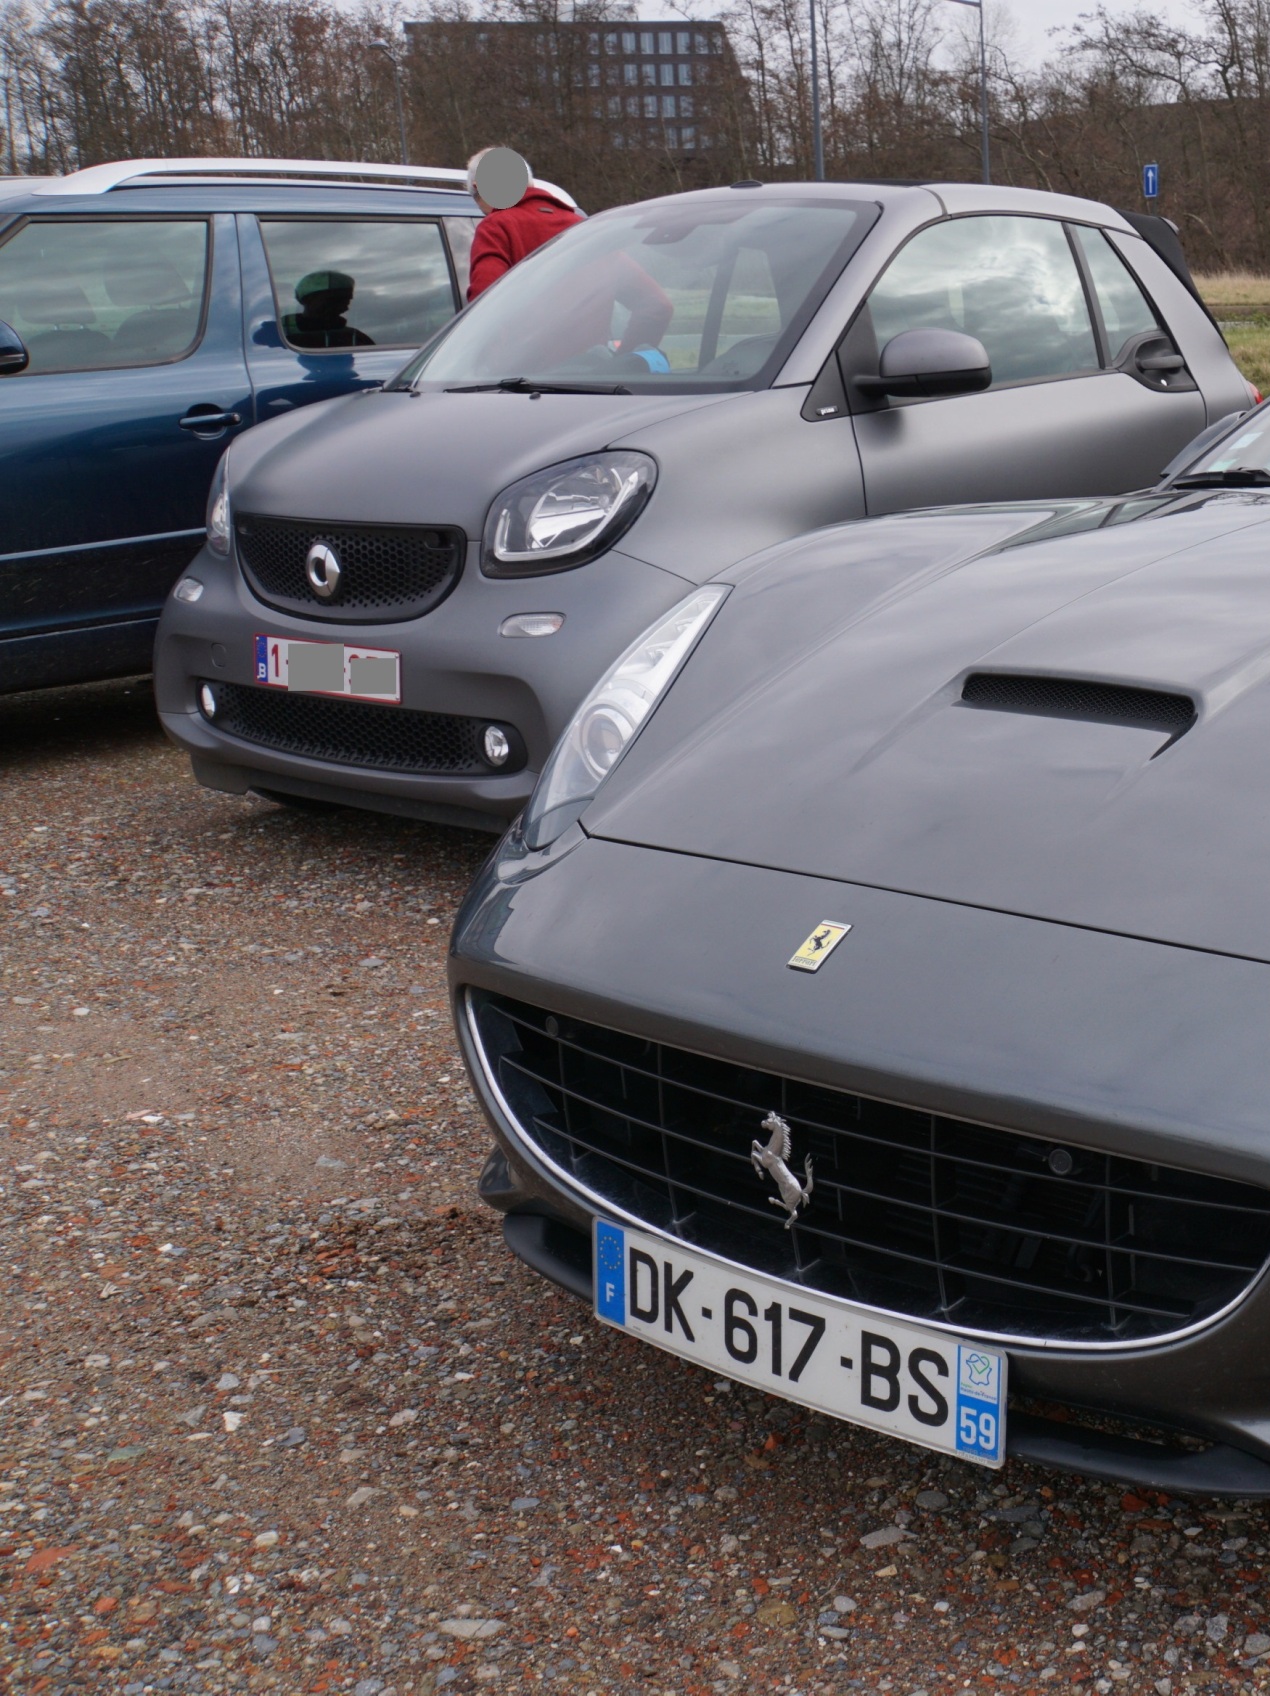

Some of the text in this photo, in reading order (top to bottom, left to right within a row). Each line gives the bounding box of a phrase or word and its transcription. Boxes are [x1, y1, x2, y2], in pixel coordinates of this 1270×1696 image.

[258, 662, 266, 679] B
[605, 1282, 615, 1303] F
[629, 1247, 949, 1427] DK-617-BS
[960, 1405, 996, 1450] 59
